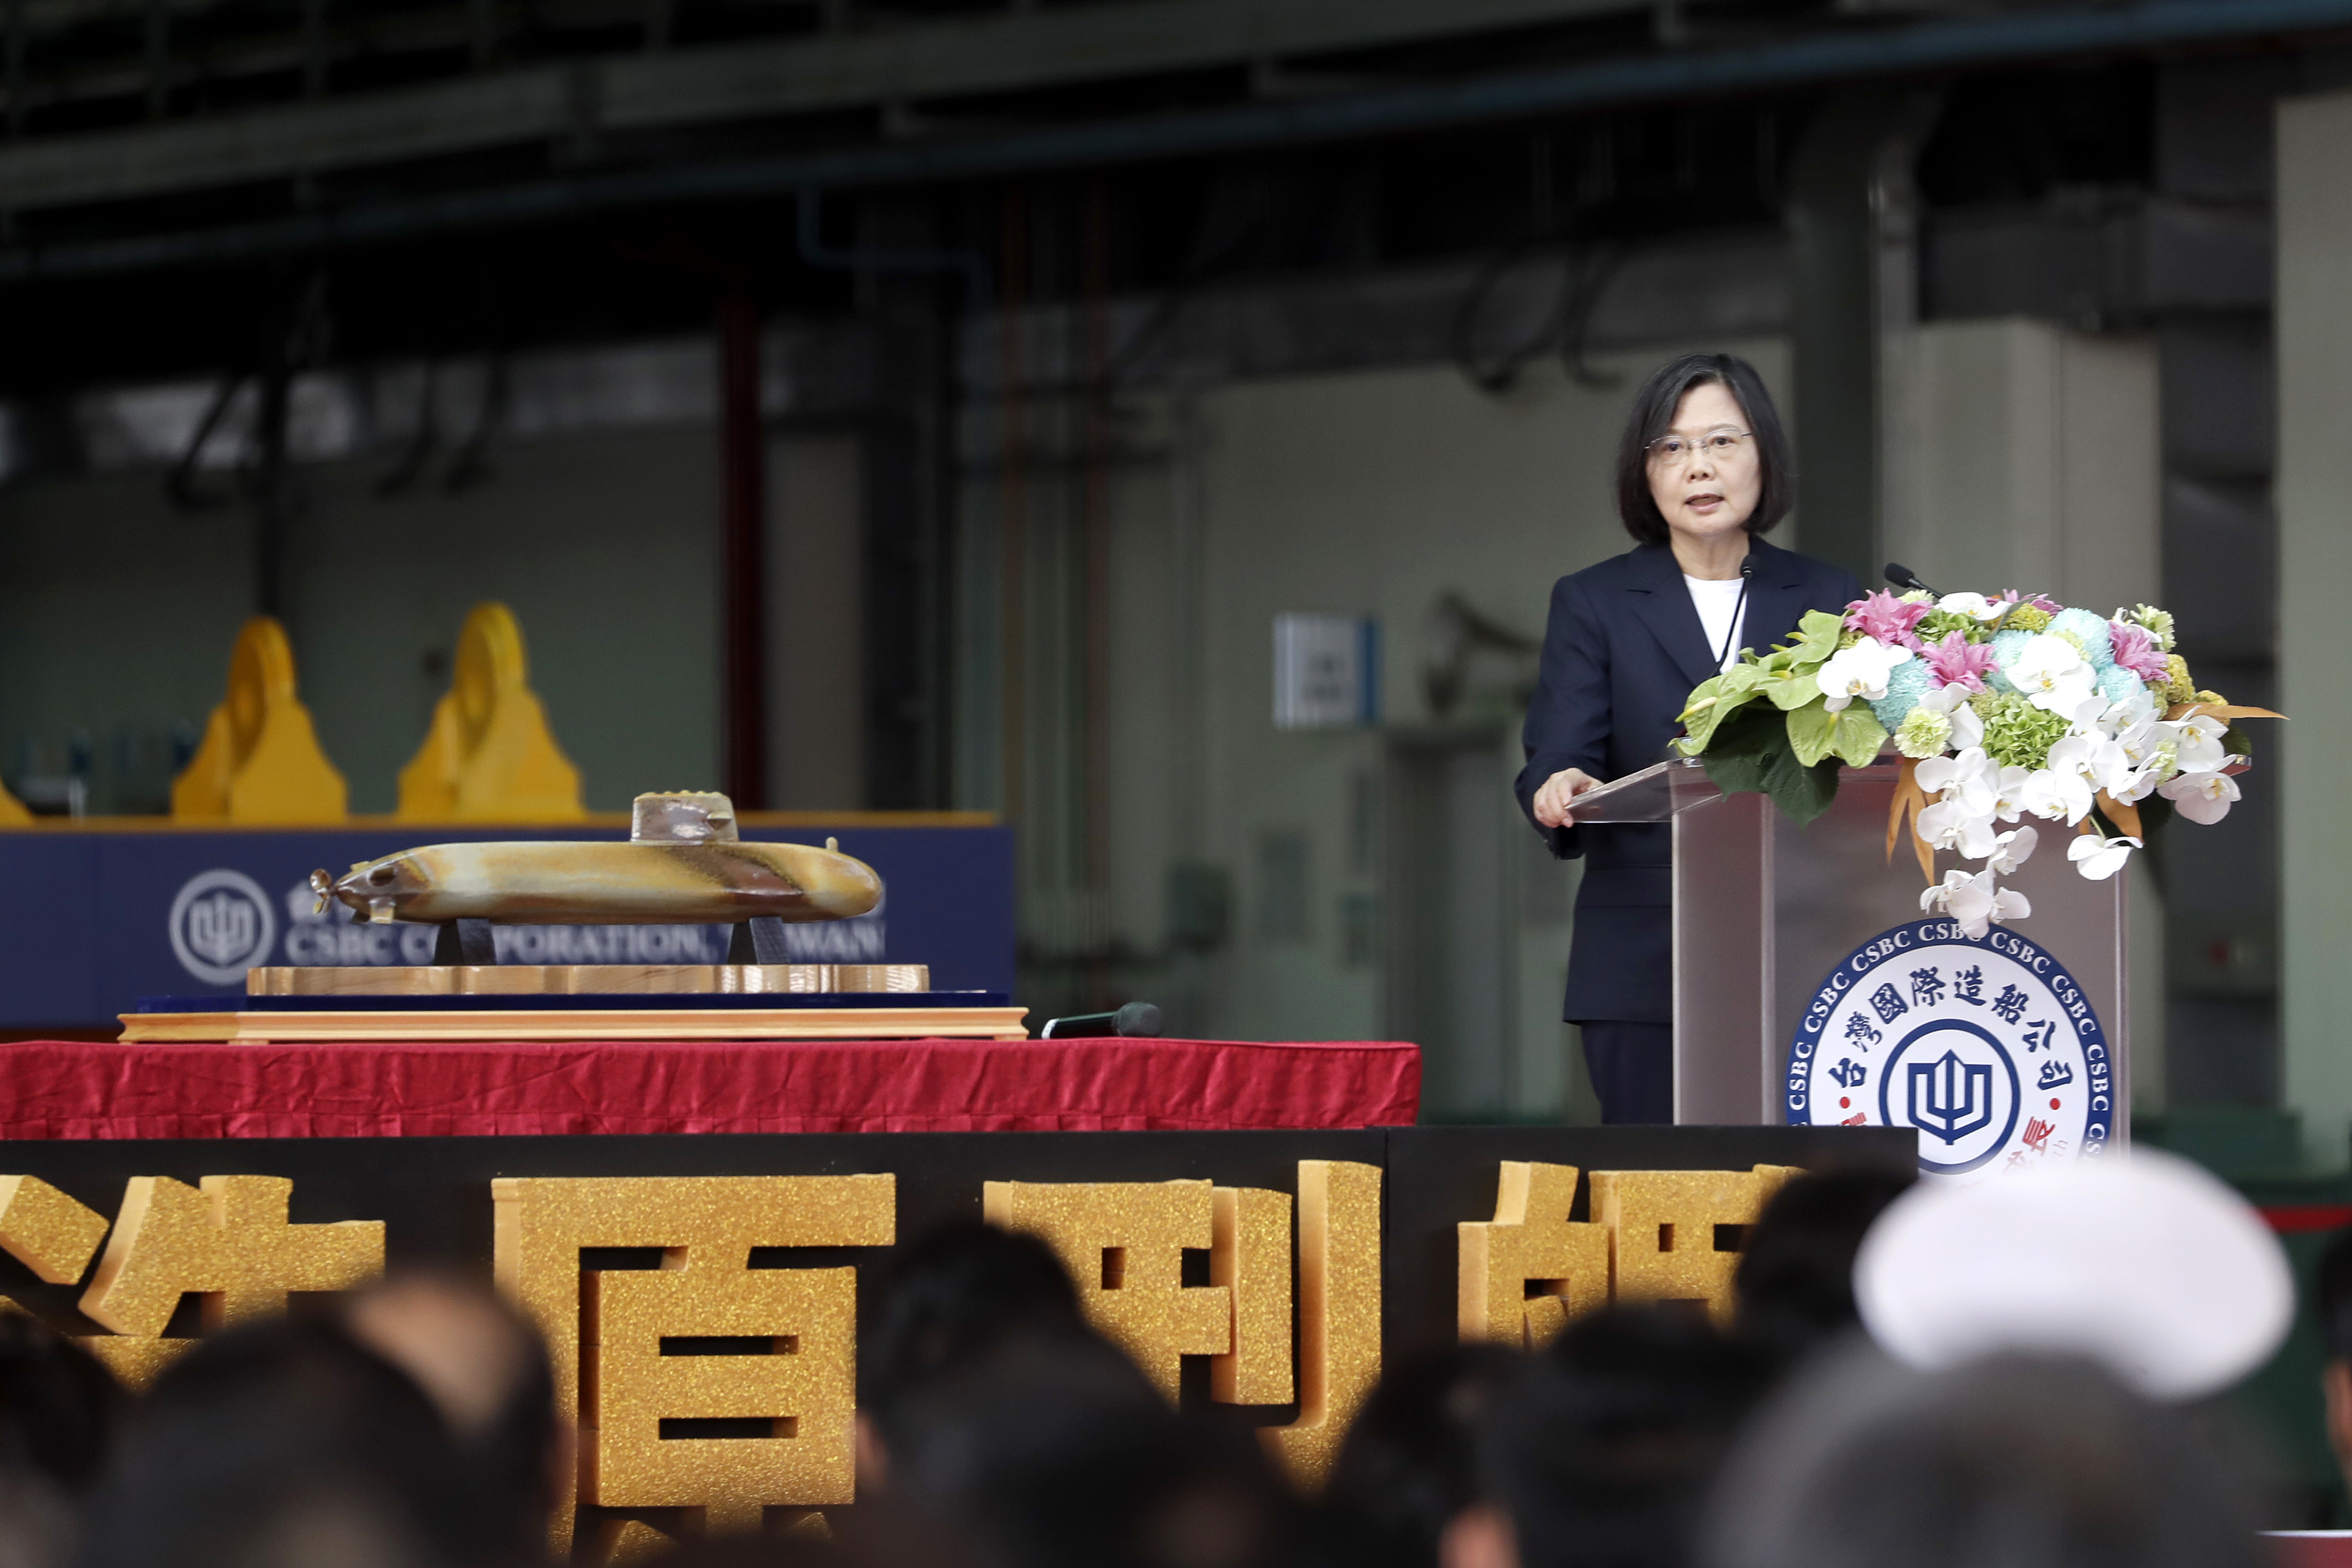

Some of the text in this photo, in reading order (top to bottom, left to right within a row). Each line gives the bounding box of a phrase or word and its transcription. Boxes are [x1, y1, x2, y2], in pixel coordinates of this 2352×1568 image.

[1851, 930, 1911, 972] CSBC
[1918, 923, 1981, 941] CSB
[1990, 931, 2051, 974] CSBC
[1804, 971, 1850, 1033] CSBC
[2051, 974, 2097, 1035] CSBC
[1788, 1042, 1813, 1111] CSBC
[2087, 1043, 2109, 1111] CSBC
